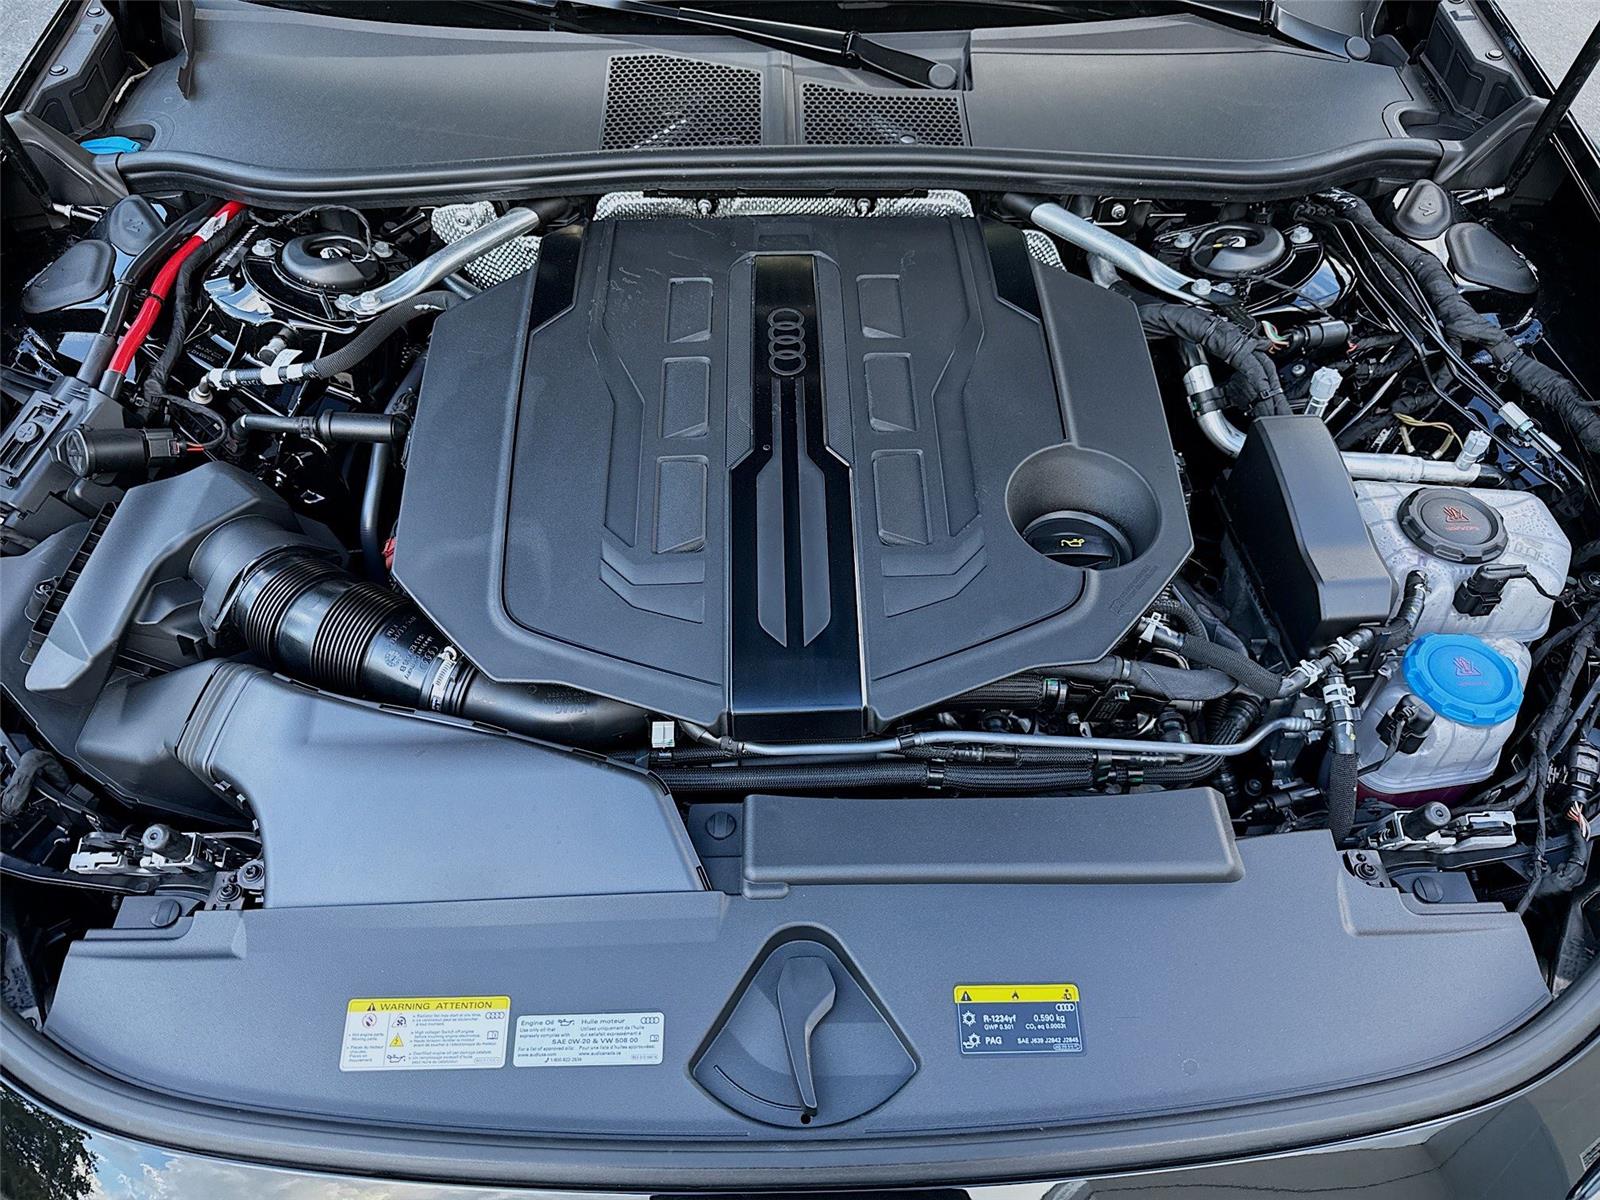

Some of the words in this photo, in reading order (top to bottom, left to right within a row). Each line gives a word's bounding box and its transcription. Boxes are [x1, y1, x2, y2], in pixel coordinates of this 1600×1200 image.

[380, 1002, 430, 1010] WARNING
[435, 1001, 493, 1010] ATTENTION
[983, 1014, 1016, 1023] R-1234yf
[1033, 1014, 1054, 1022] 0.590
[1056, 1014, 1065, 1023] kg
[985, 1037, 1002, 1045] PAG
